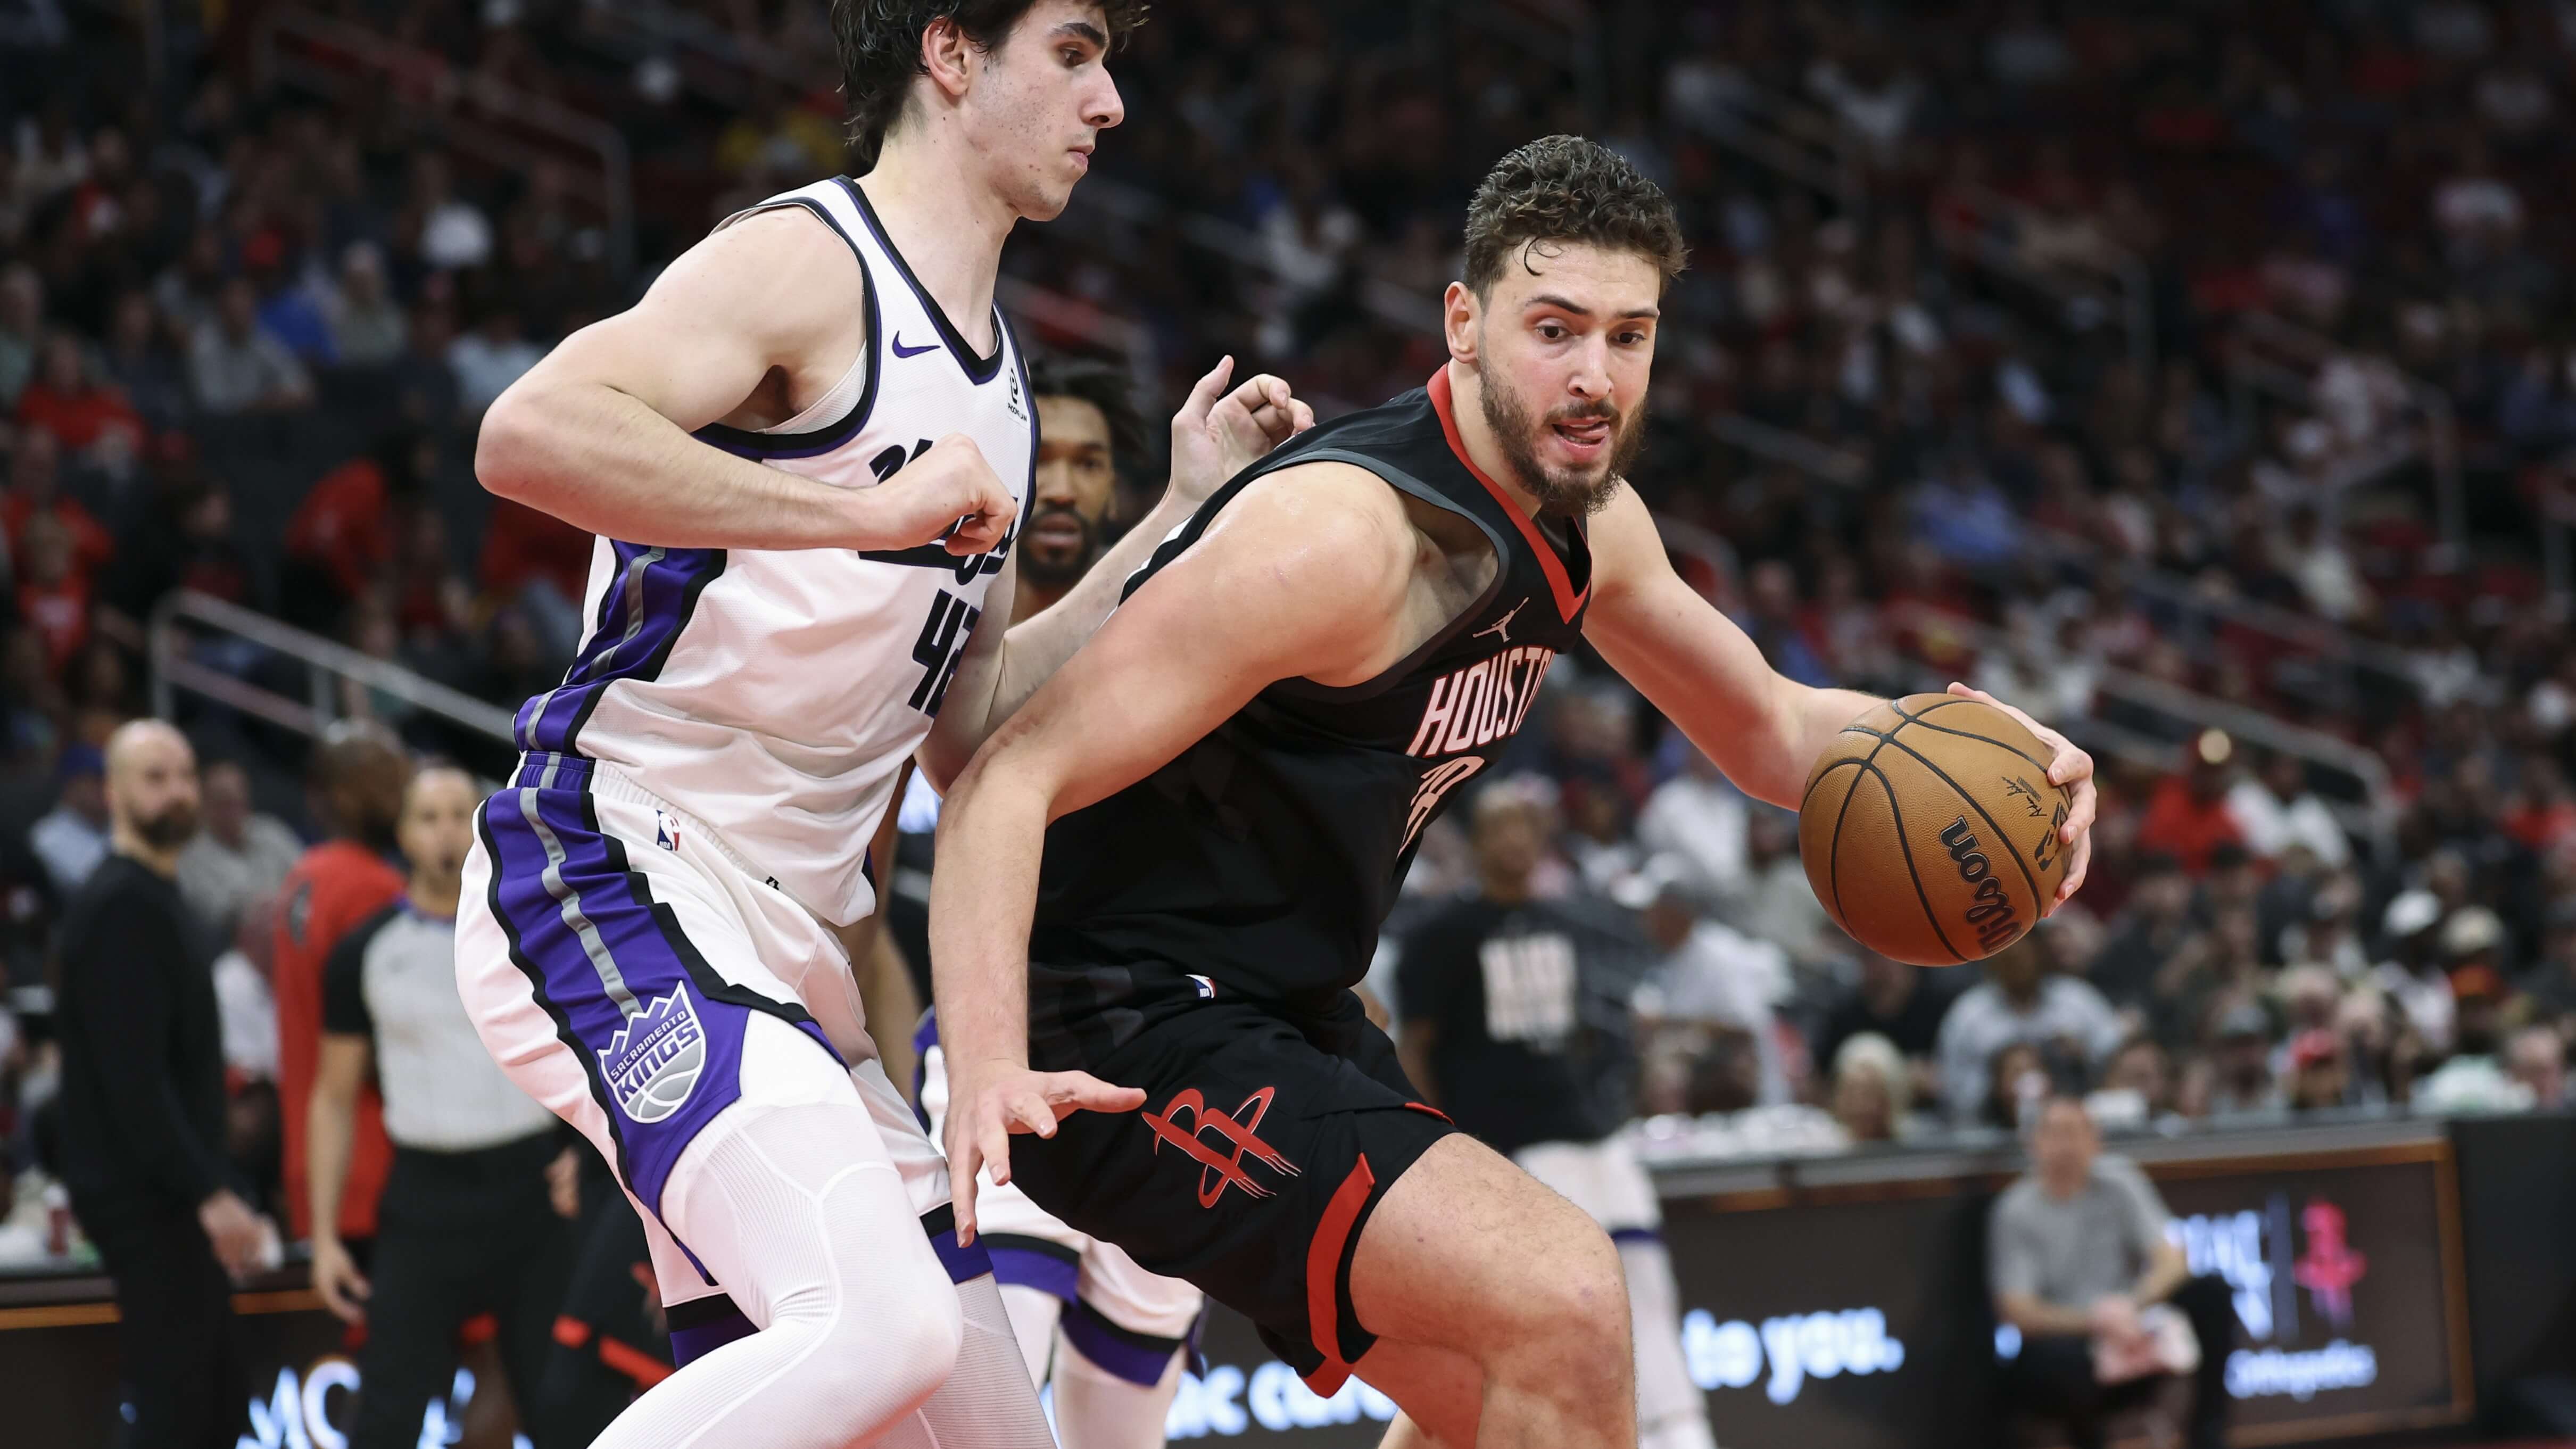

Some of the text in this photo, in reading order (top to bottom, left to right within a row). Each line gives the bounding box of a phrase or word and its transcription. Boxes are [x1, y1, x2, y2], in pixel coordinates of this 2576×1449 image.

[1405, 645, 1555, 758] HOUSTO
[610, 1011, 688, 1080] SACRAMENTO
[616, 1021, 700, 1105] KINGS
